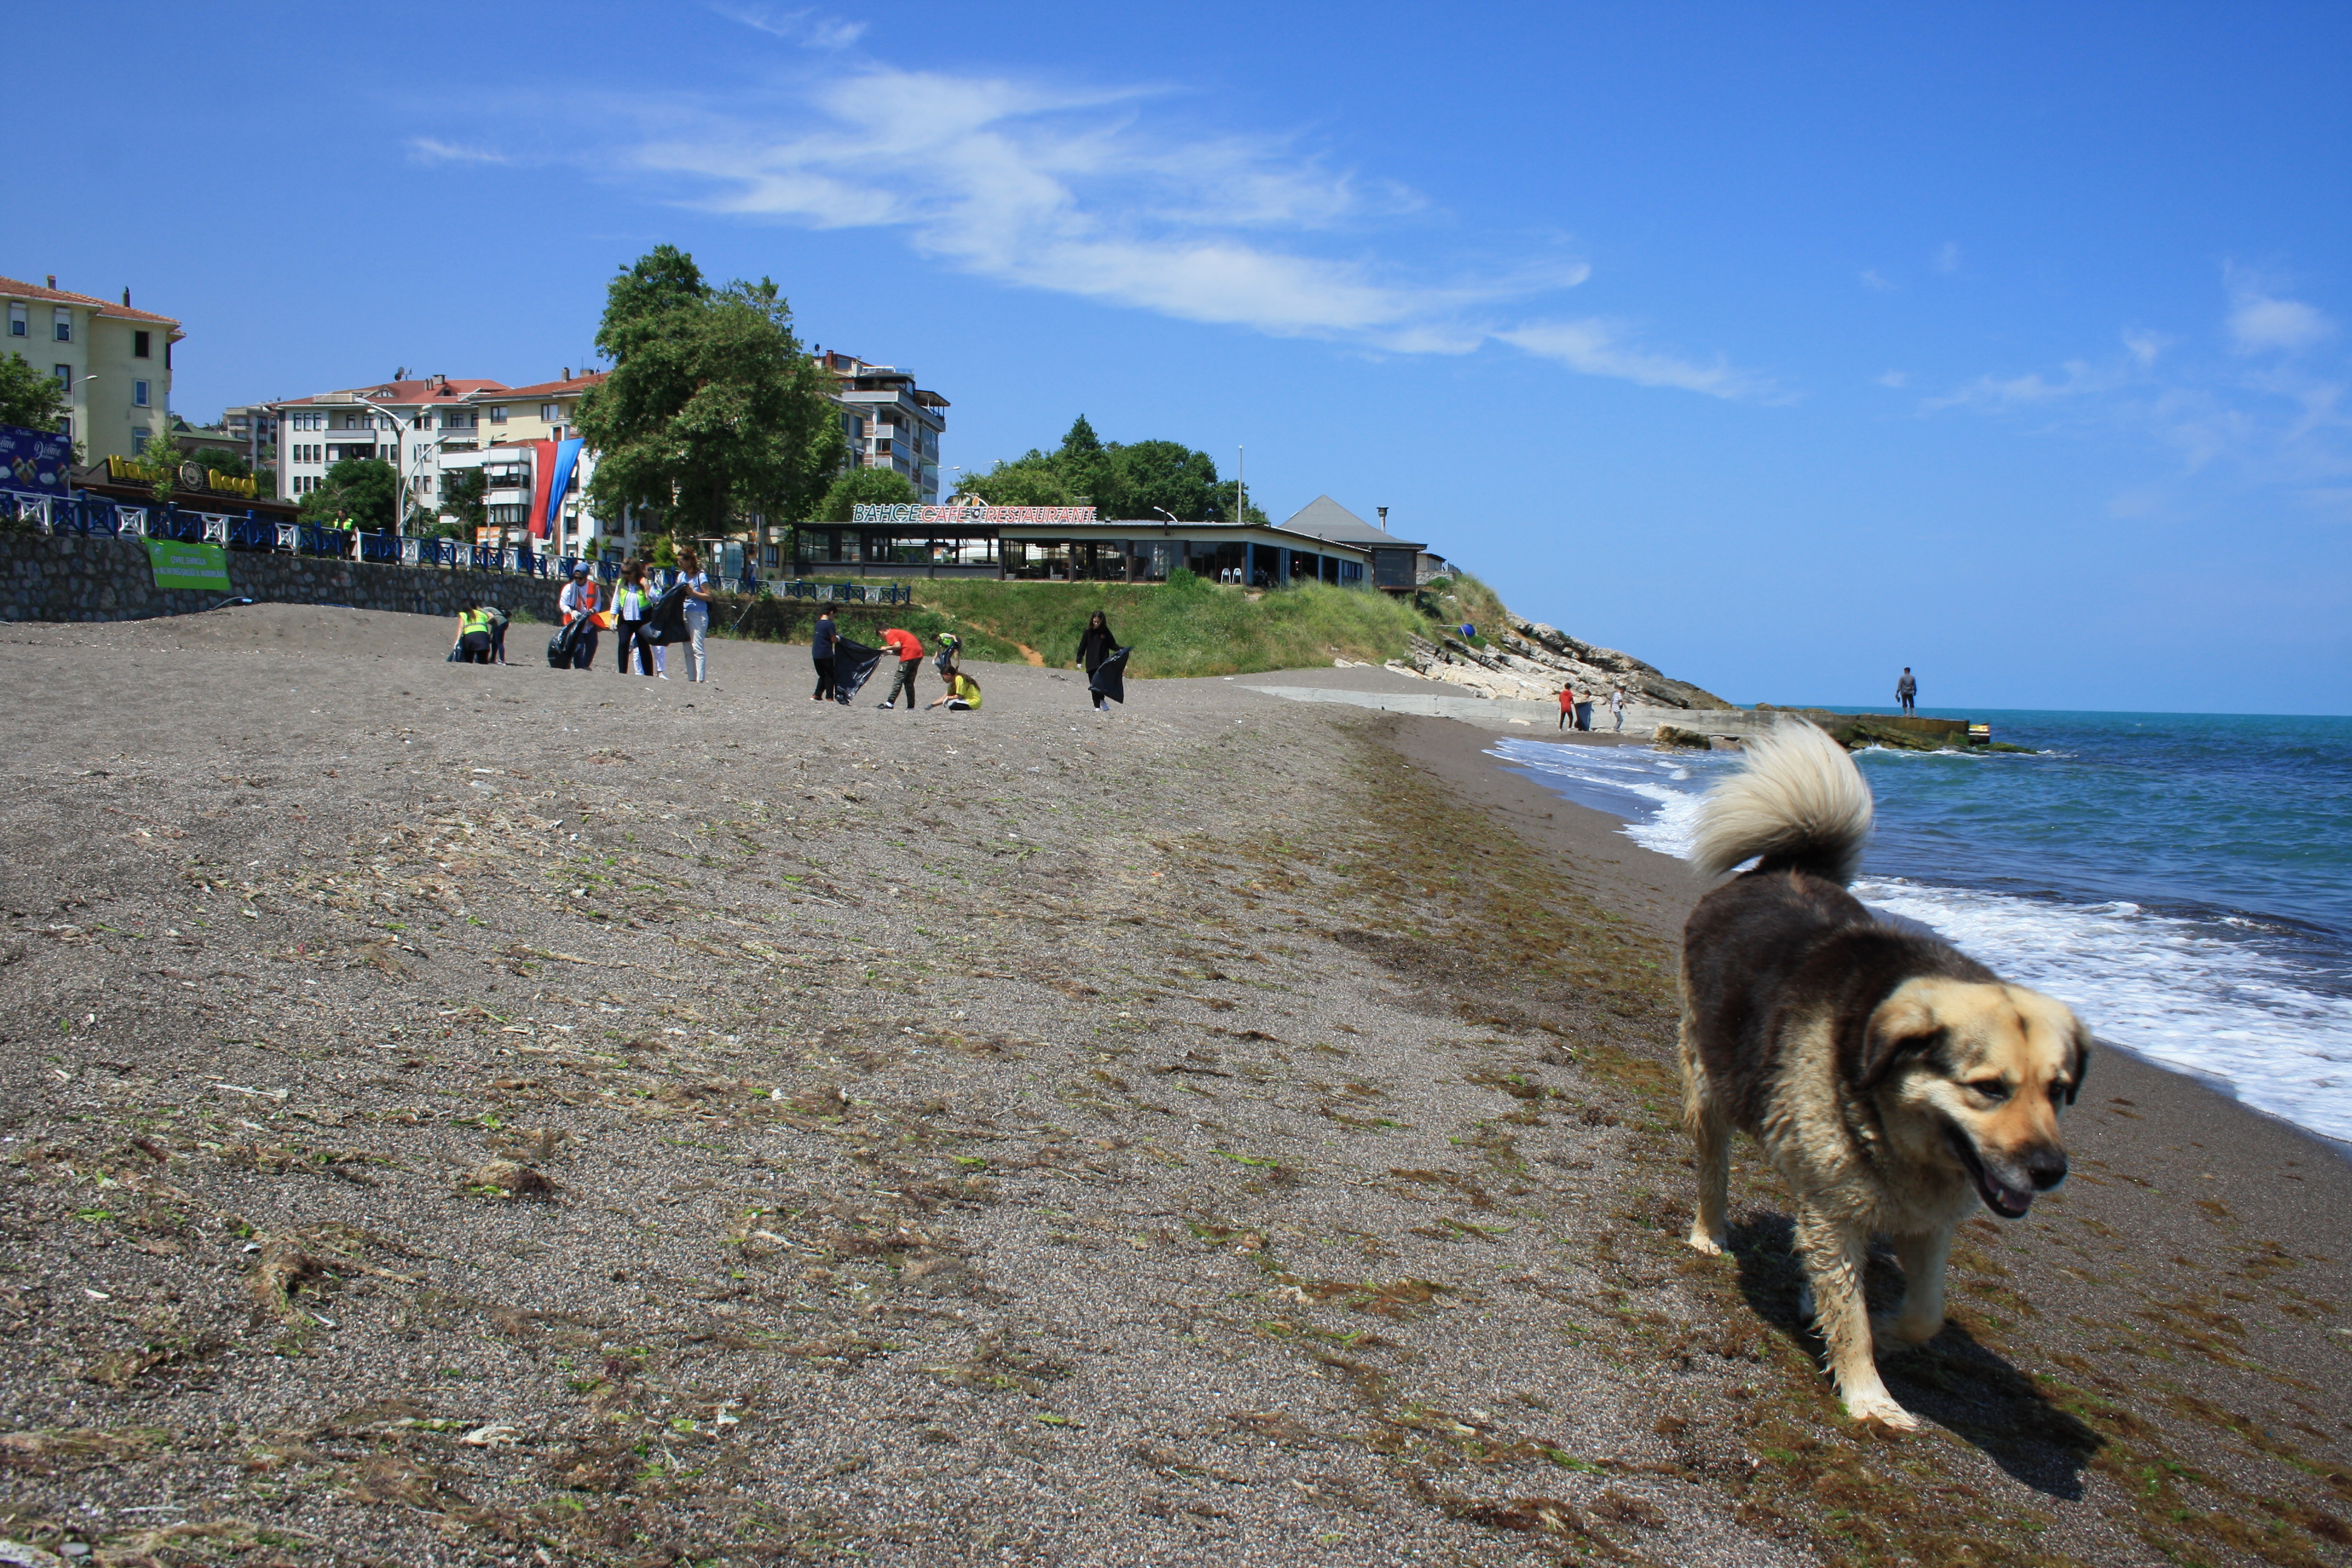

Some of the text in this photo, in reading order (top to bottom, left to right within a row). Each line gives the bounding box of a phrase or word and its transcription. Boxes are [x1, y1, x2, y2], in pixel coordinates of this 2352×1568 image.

[209, 469, 258, 499] Rengi
[922, 506, 966, 522] CAFE
[985, 506, 1096, 523] RESTAURANT
